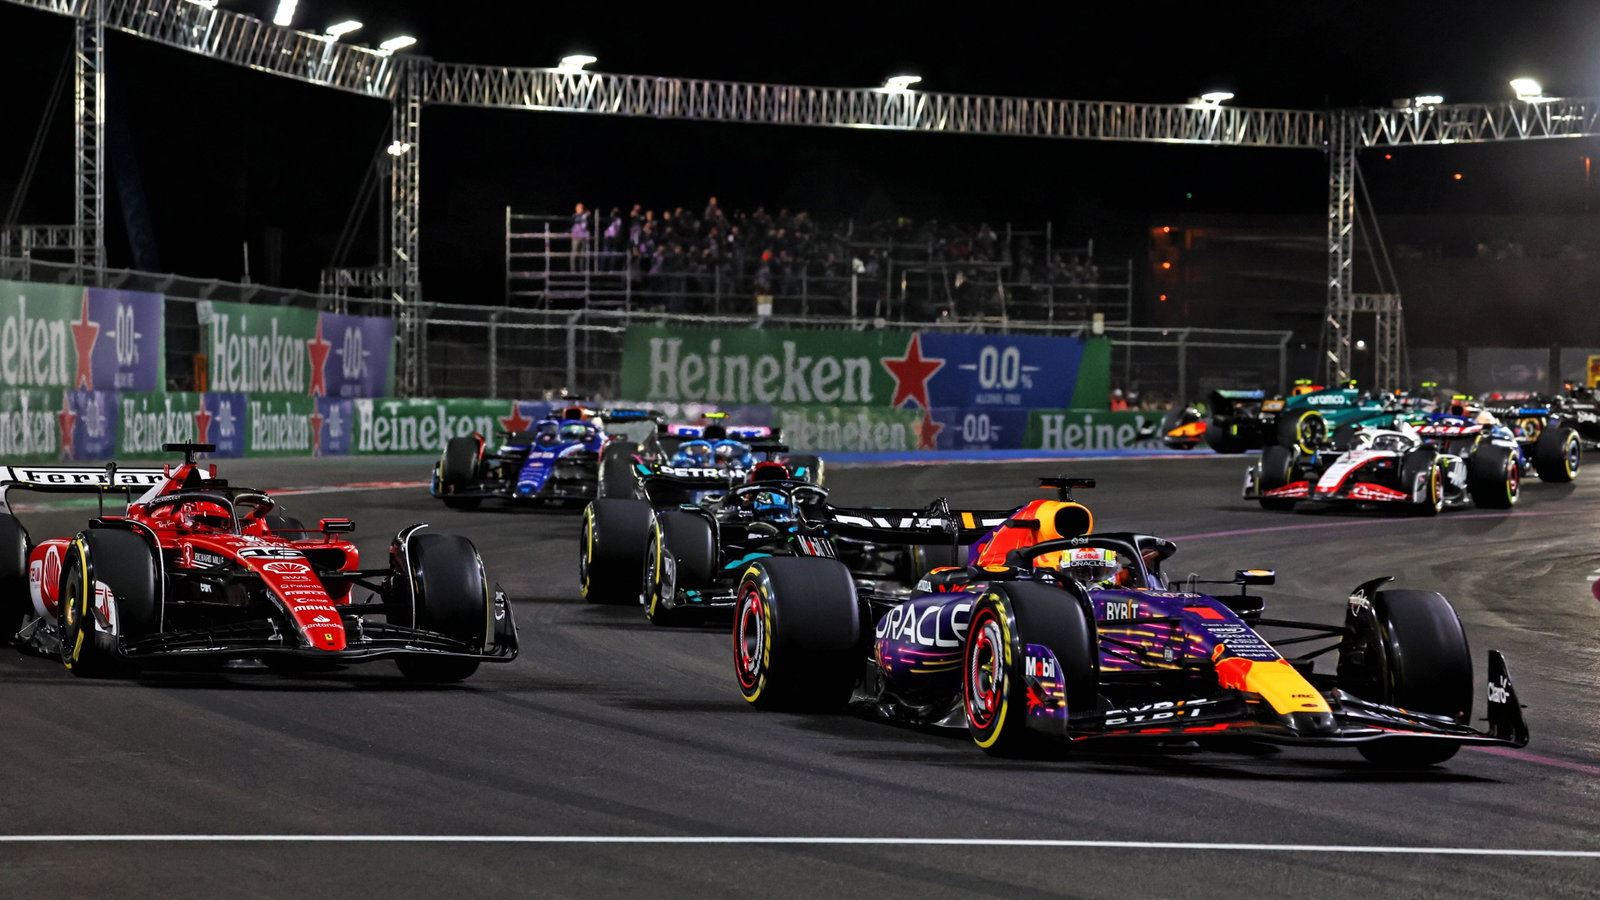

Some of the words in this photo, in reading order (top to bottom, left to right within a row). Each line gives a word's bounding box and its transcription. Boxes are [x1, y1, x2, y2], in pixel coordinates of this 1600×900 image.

[211, 313, 305, 393] Heineken
[648, 337, 873, 402] Heineken
[1307, 395, 1345, 405] aramco
[123, 398, 193, 453] Heineken
[252, 401, 309, 450] Heineken
[781, 411, 906, 450] Heineken
[1039, 414, 1163, 450] Heine
[23, 470, 164, 485] Ferrar
[661, 466, 747, 479] PETRON
[194, 552, 212, 563] RICHARD
[1025, 656, 1055, 679] Mobil
[1487, 681, 1510, 704] Claro
